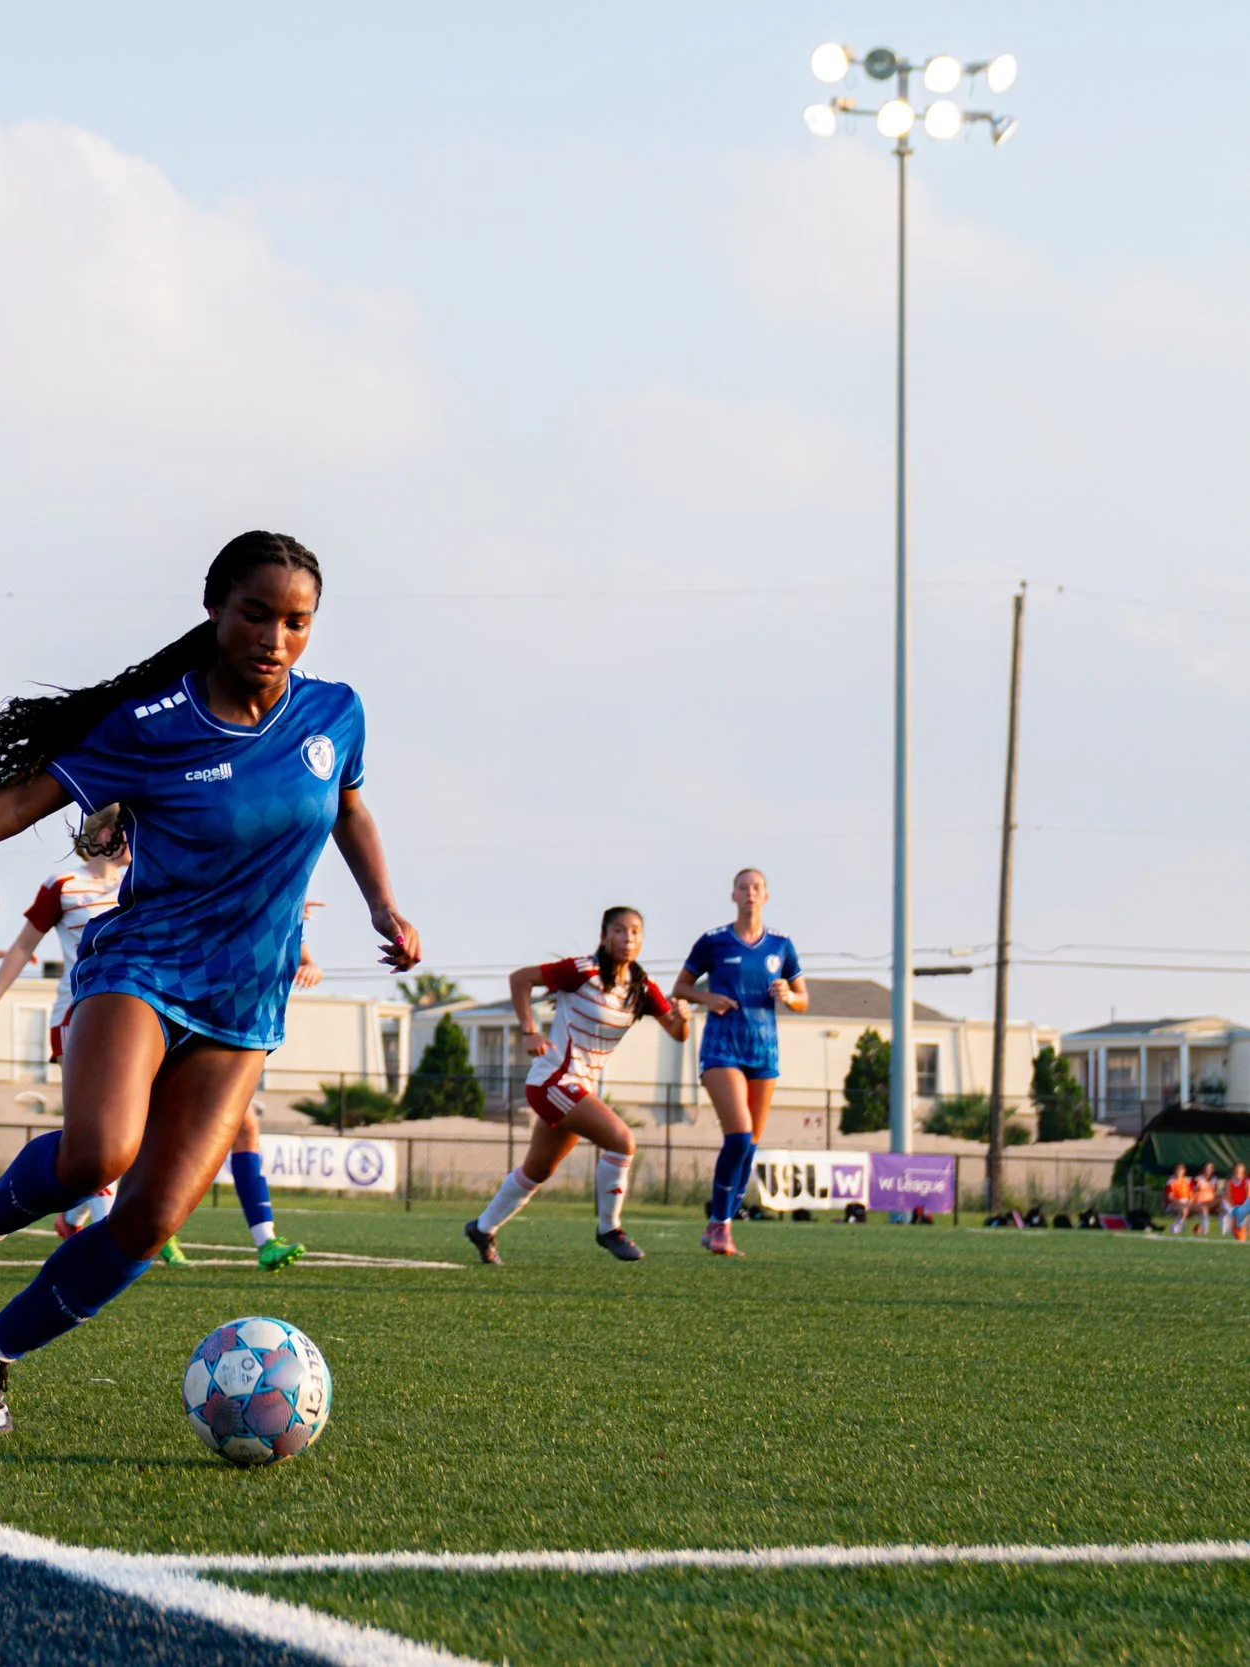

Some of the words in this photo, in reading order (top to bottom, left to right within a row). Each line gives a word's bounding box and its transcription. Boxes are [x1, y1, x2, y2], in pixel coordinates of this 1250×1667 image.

[185, 762, 232, 782] capelli
[271, 1145, 334, 1177] AHFC
[755, 1163, 829, 1198] USL
[834, 1169, 863, 1196] W
[878, 1176, 894, 1192] W
[896, 1174, 946, 1197] League
[297, 1335, 324, 1418] SELECT
